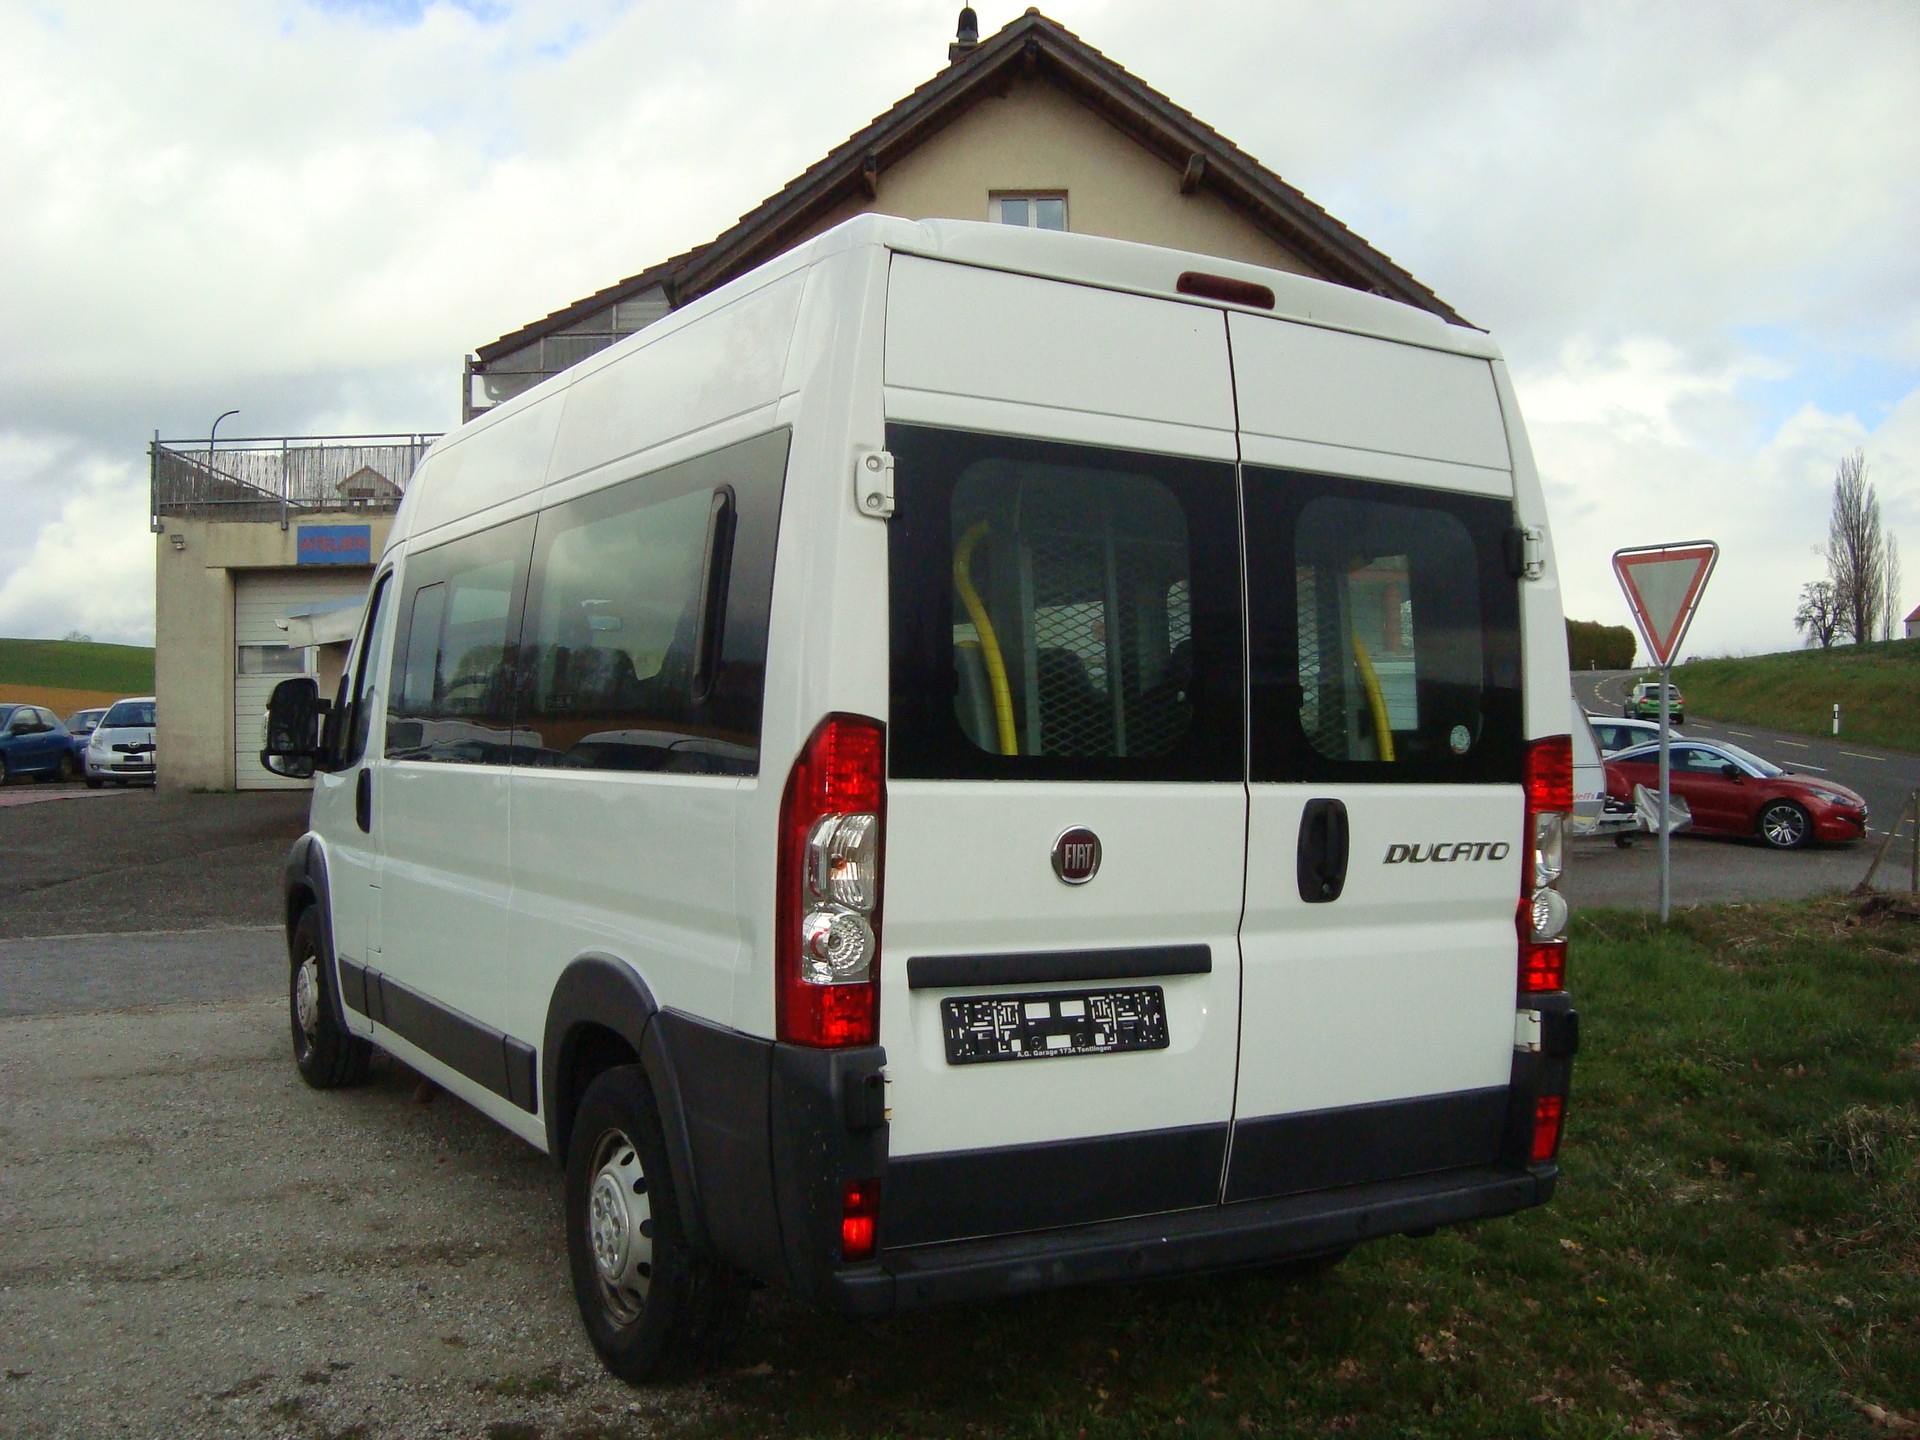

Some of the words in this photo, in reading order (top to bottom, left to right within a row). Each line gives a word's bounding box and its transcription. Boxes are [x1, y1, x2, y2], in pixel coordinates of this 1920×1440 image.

[1064, 843, 1093, 869] FIAT
[1383, 842, 1510, 864] DUCATO
[1033, 1048, 1058, 1057] Garage
[1060, 1046, 1077, 1055] 1734
